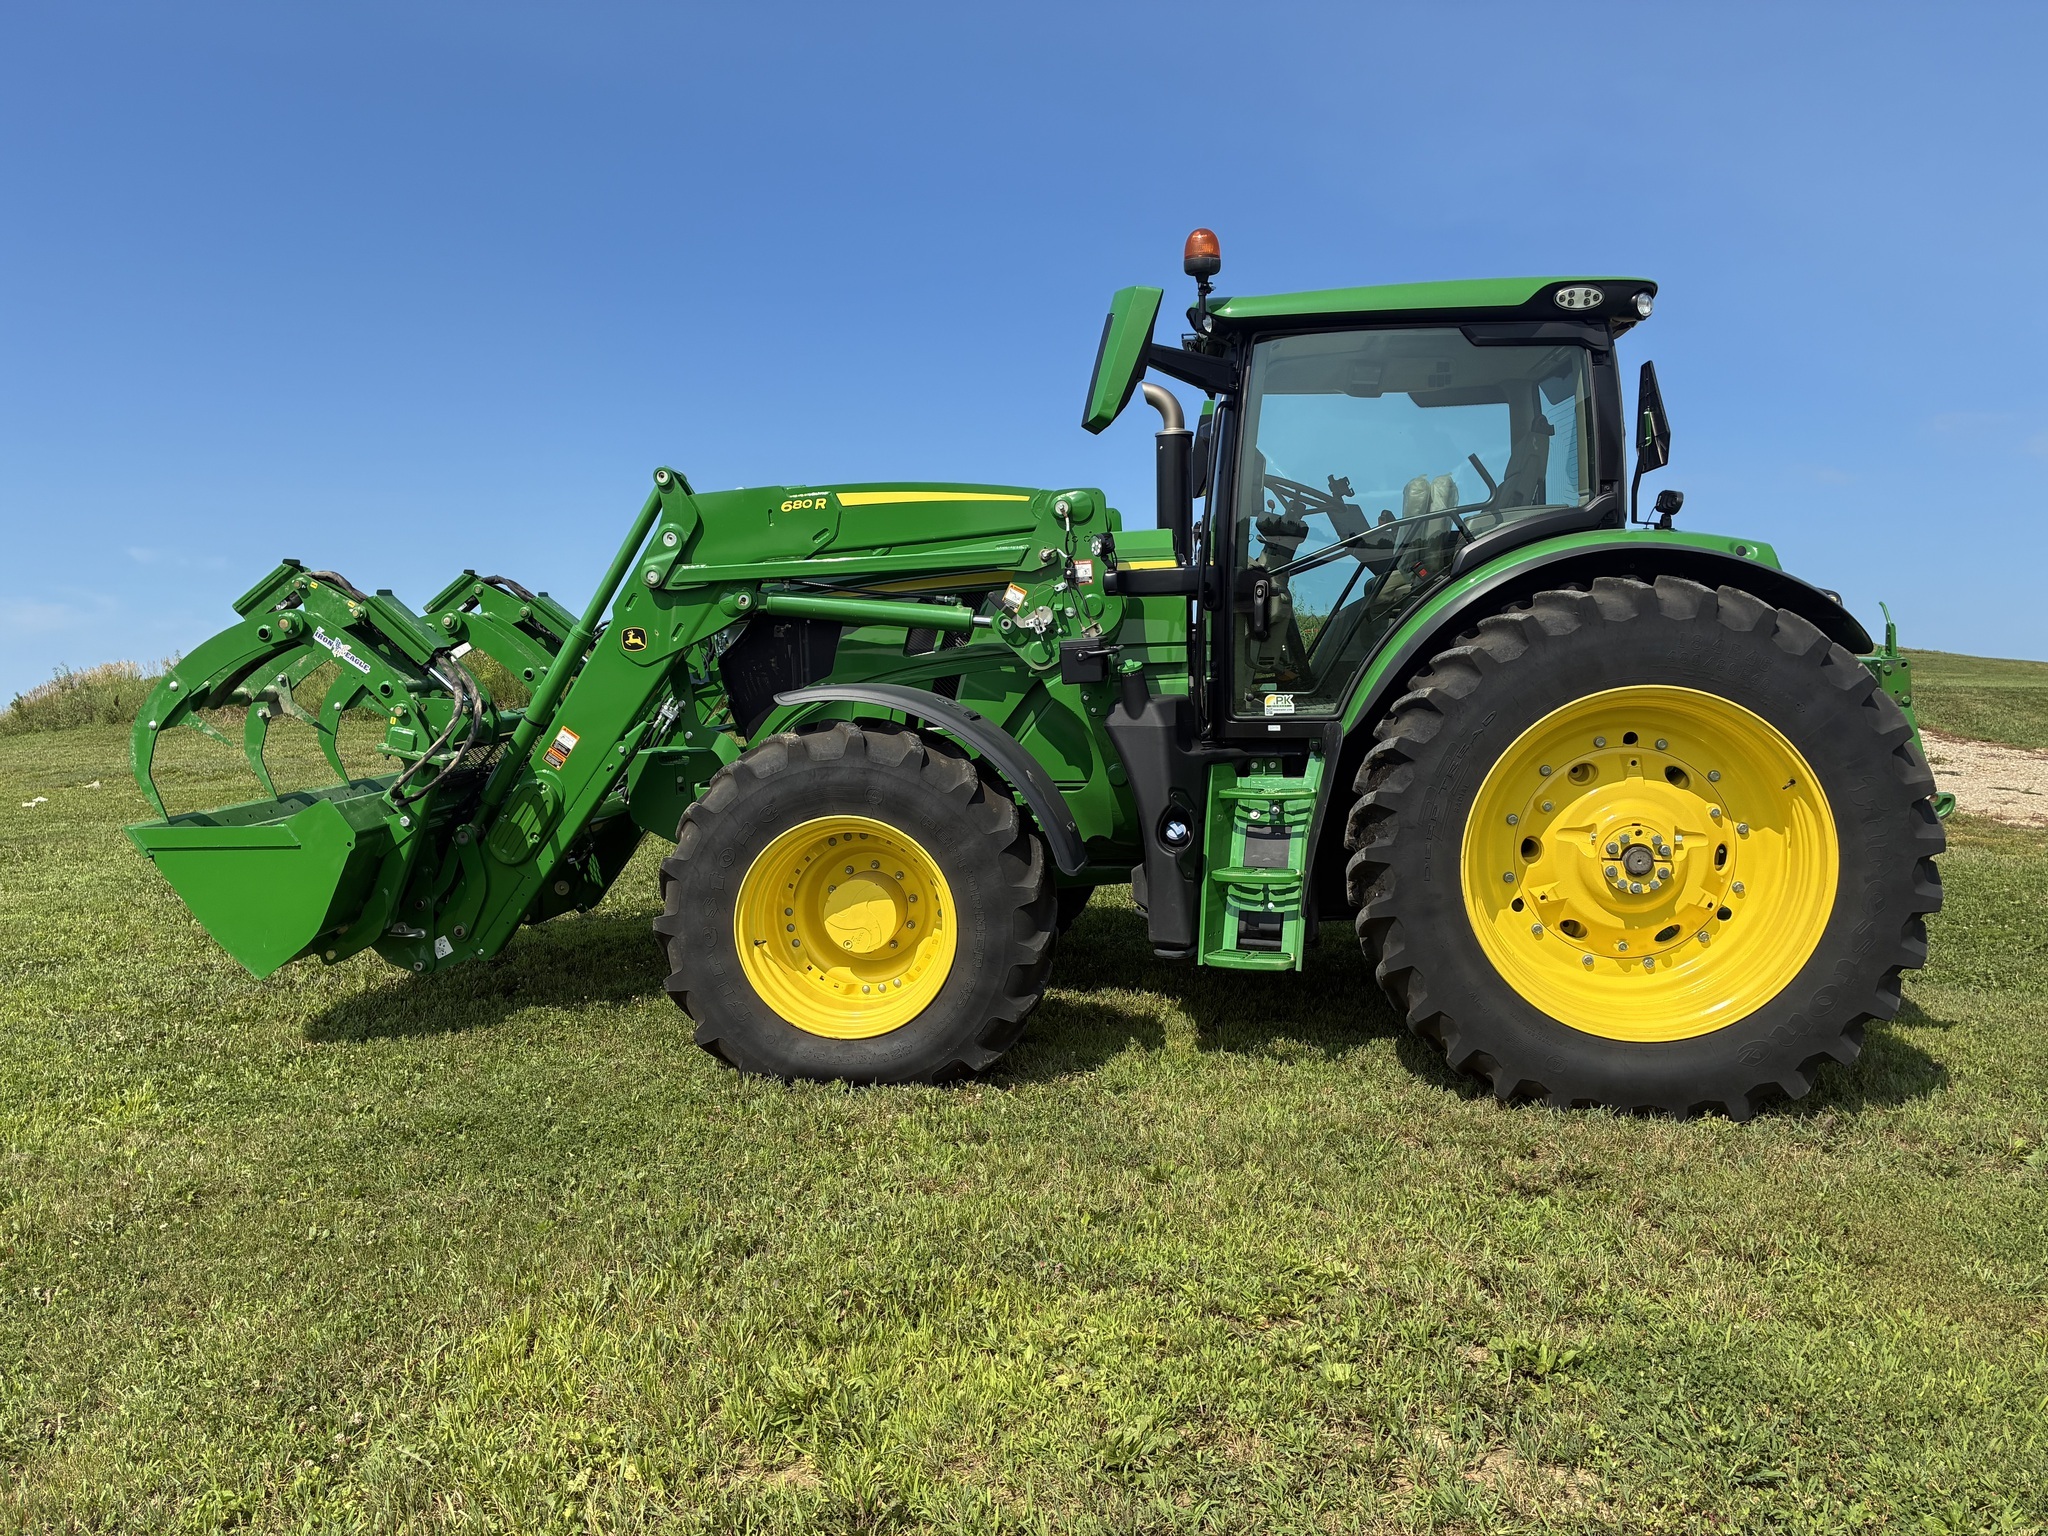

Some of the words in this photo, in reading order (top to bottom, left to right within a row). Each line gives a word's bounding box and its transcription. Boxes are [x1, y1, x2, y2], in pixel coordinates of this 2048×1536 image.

[781, 499, 813, 512] 680
[815, 498, 827, 510] R
[314, 631, 334, 647] IRON
[345, 652, 370, 671] EAGLE
